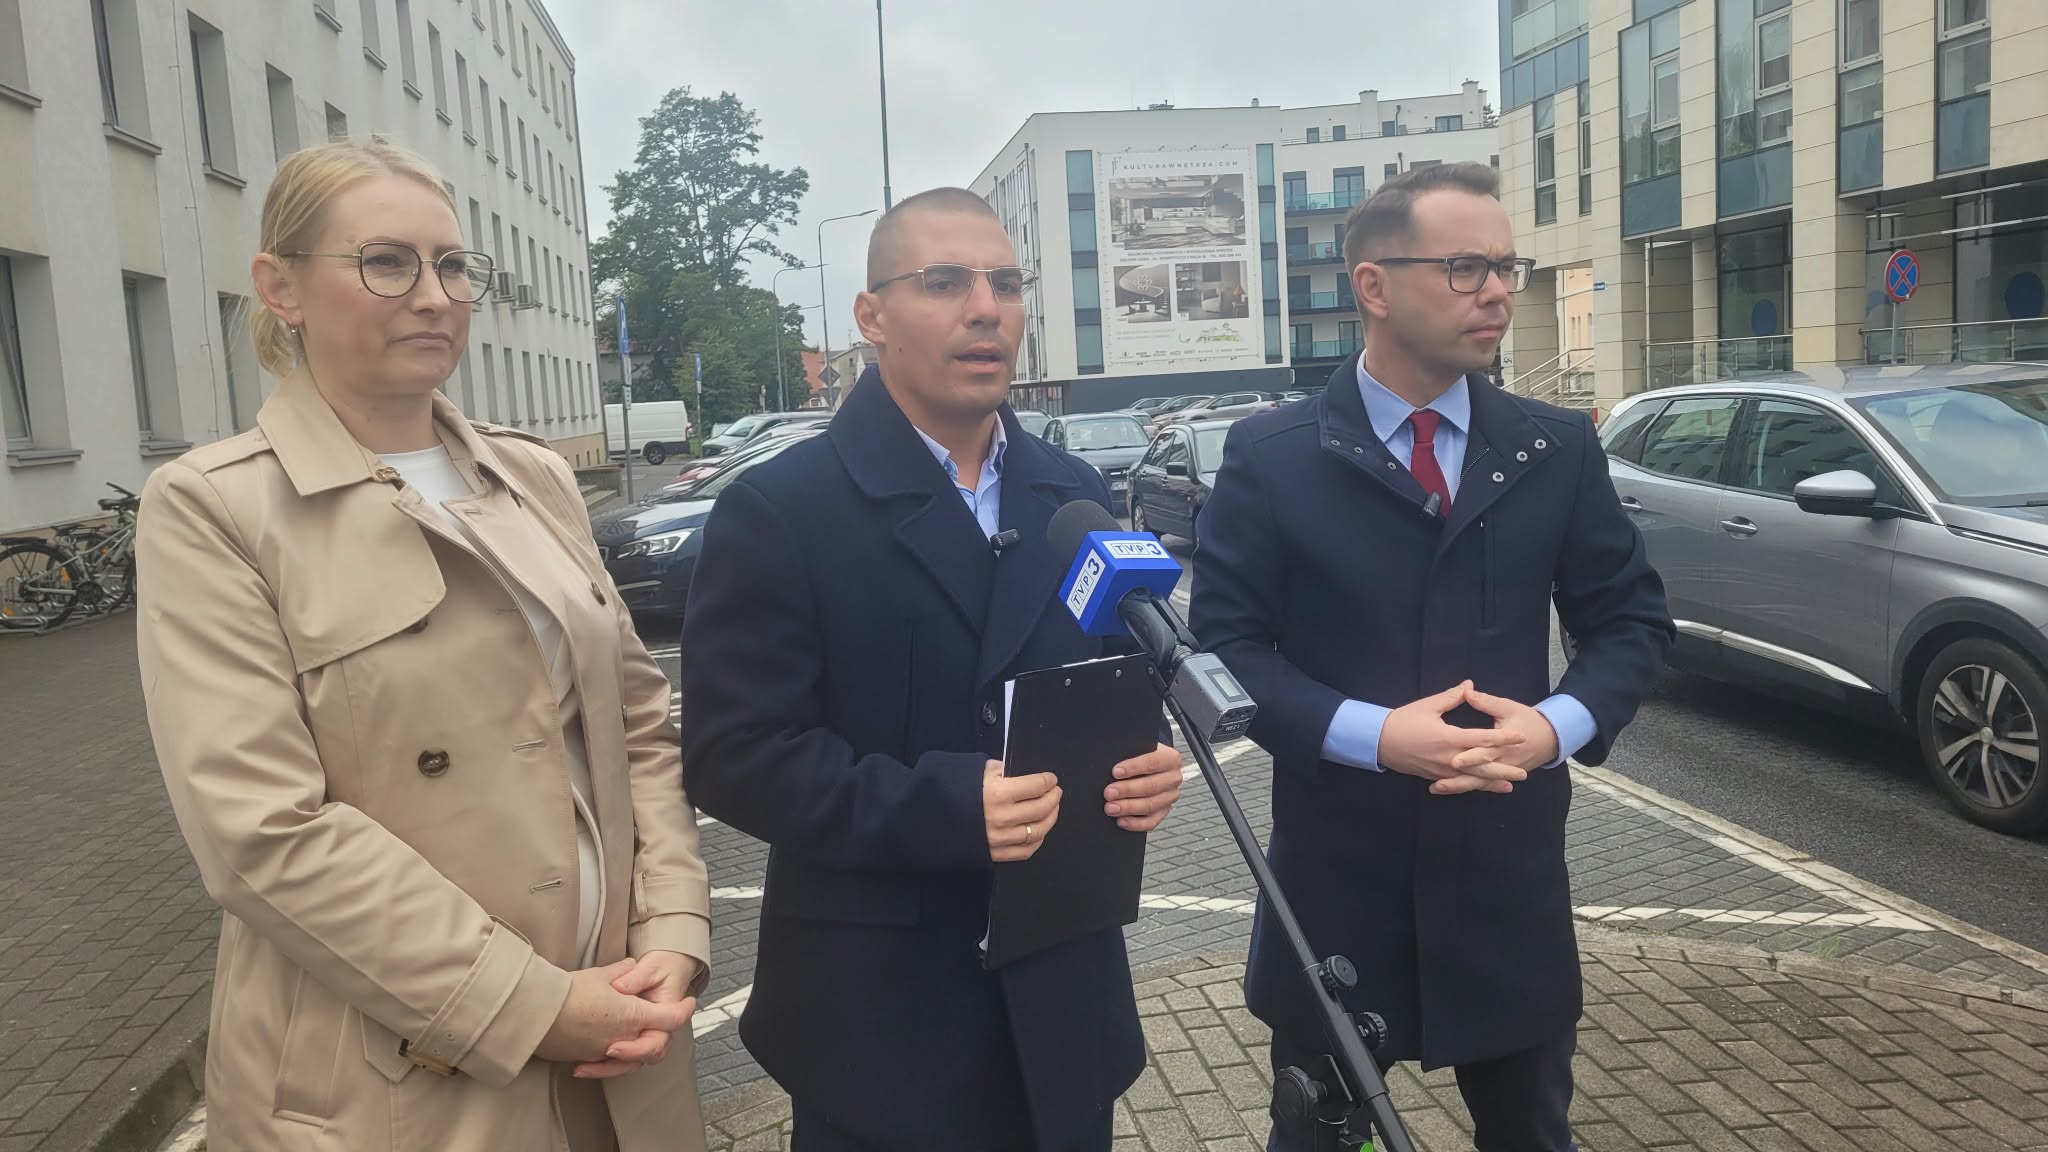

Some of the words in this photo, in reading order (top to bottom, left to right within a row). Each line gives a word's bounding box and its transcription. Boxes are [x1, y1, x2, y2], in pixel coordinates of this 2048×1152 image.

[1113, 544, 1146, 554] TVP
[1146, 543, 1162, 555] 3
[1072, 574, 1091, 606] TVP
[1088, 557, 1100, 575] 3
